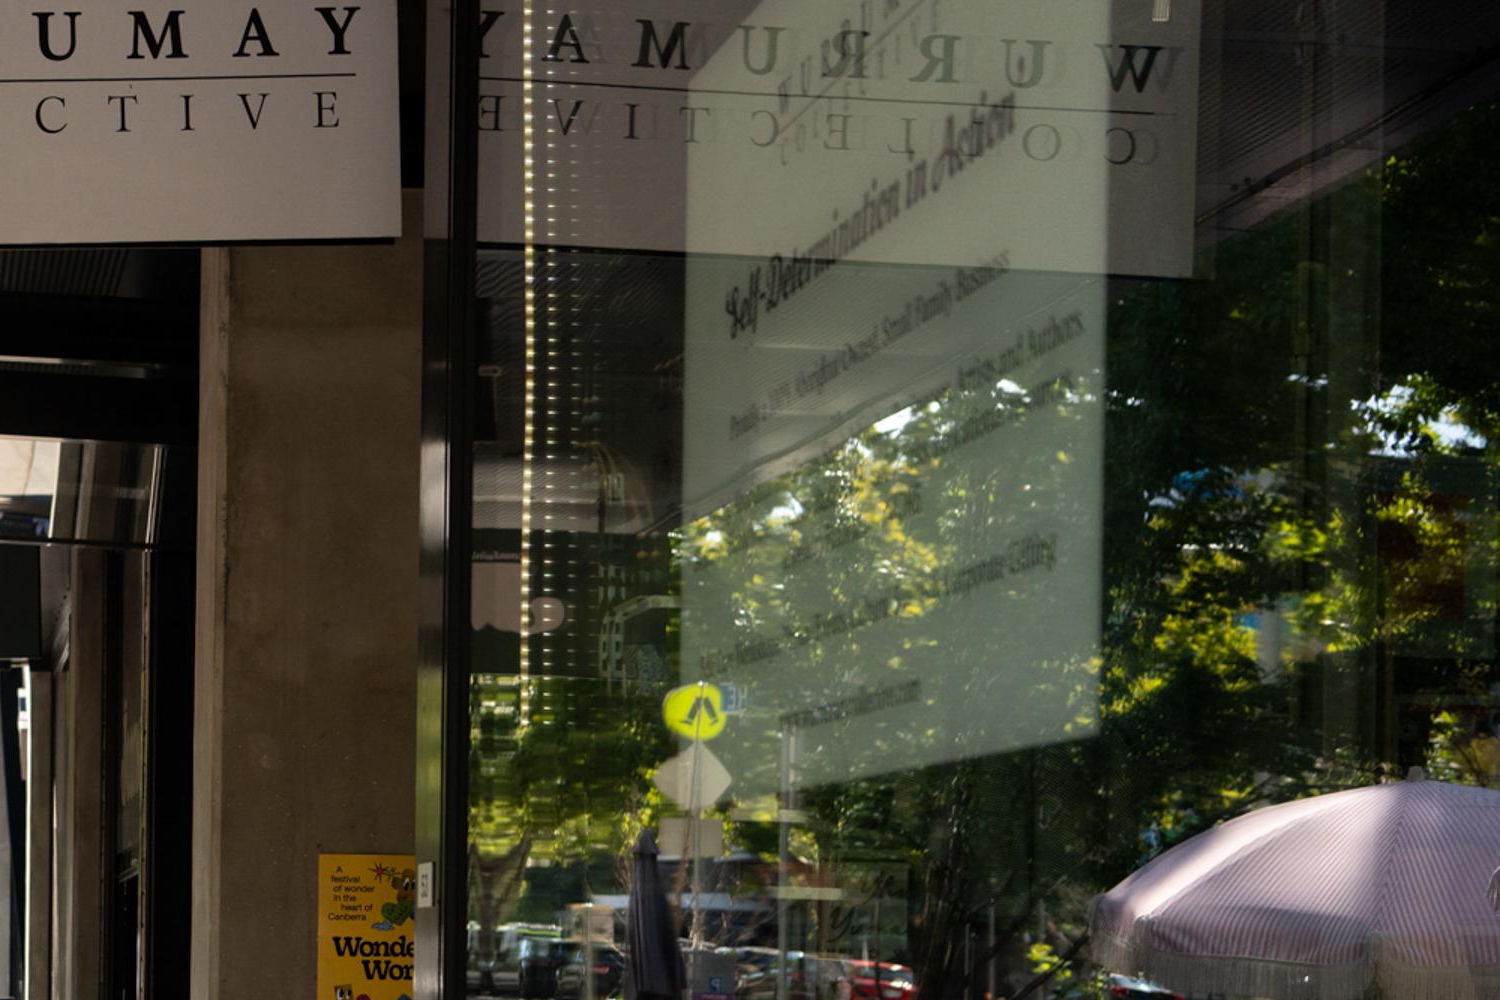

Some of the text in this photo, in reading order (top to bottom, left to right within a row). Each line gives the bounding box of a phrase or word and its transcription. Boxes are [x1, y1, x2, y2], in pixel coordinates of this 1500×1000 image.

[935, 90, 1015, 192] Action
[331, 875, 360, 883] festival
[343, 894, 356, 902] the
[328, 912, 367, 921] Canberra
